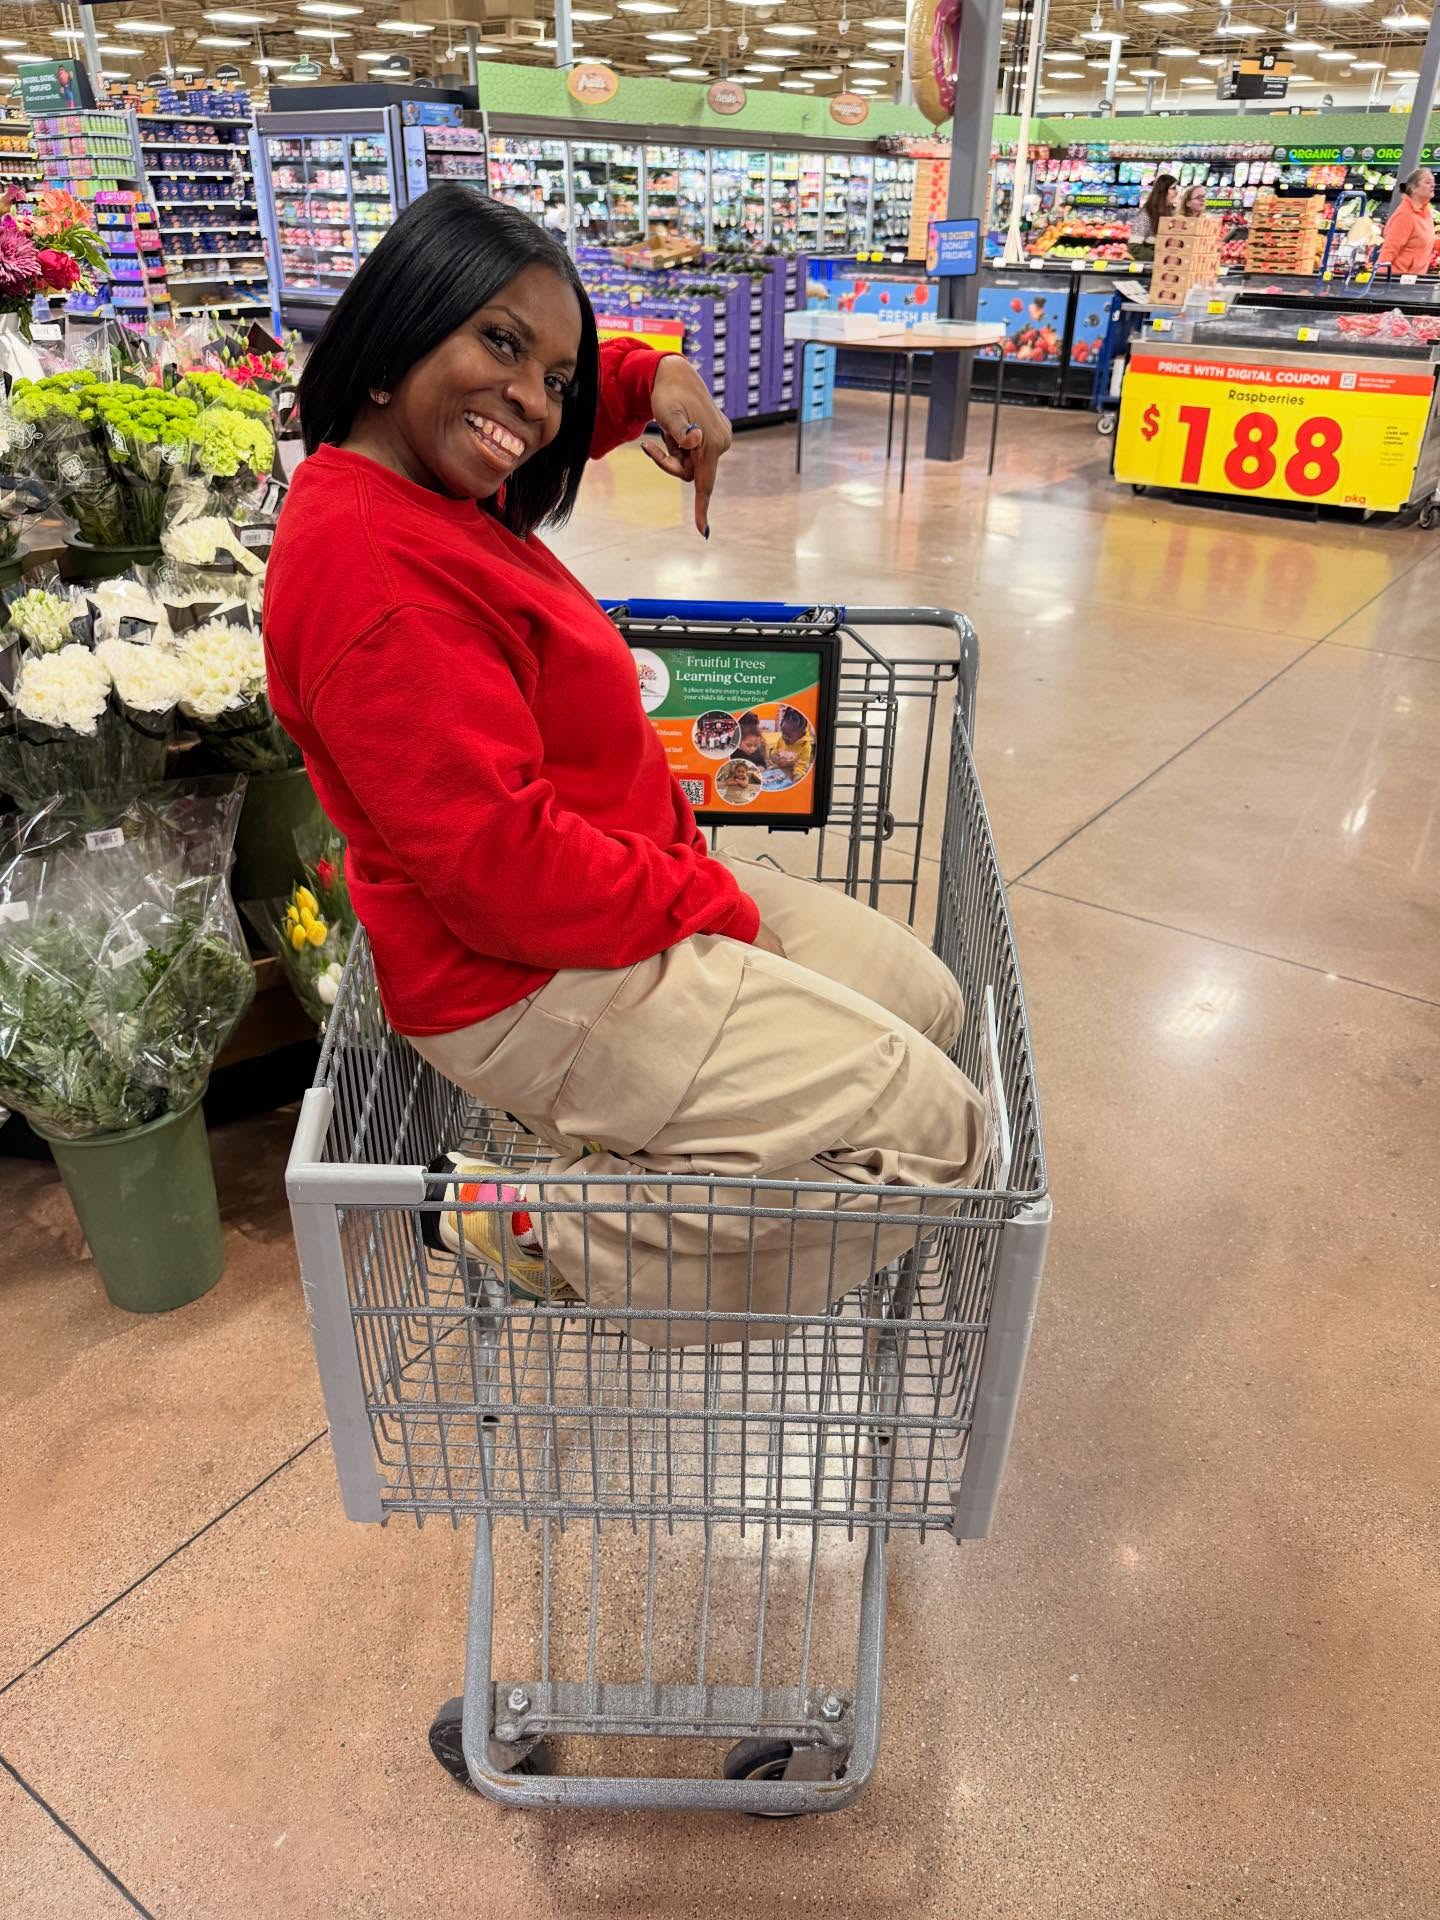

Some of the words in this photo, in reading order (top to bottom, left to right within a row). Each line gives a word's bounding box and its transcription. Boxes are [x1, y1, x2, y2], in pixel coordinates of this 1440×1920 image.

[1263, 55, 1275, 68] 16
[1289, 148, 1341, 159] ORGANIC
[1376, 148, 1432, 159] ORGC
[1075, 195, 1107, 204] ORGANIC
[879, 309, 920, 323] FRESH
[1157, 361, 1191, 375] PRICE
[1194, 364, 1225, 378] WITH
[1227, 367, 1272, 382] DIGITAL
[1276, 371, 1331, 386] COUPON
[1228, 389, 1306, 407] Raspberries
[687, 656, 730, 668] Fruitful
[733, 657, 766, 670] Trees
[675, 670, 732, 686] Learning
[734, 672, 776, 685] Center
[722, 688, 739, 696] every
